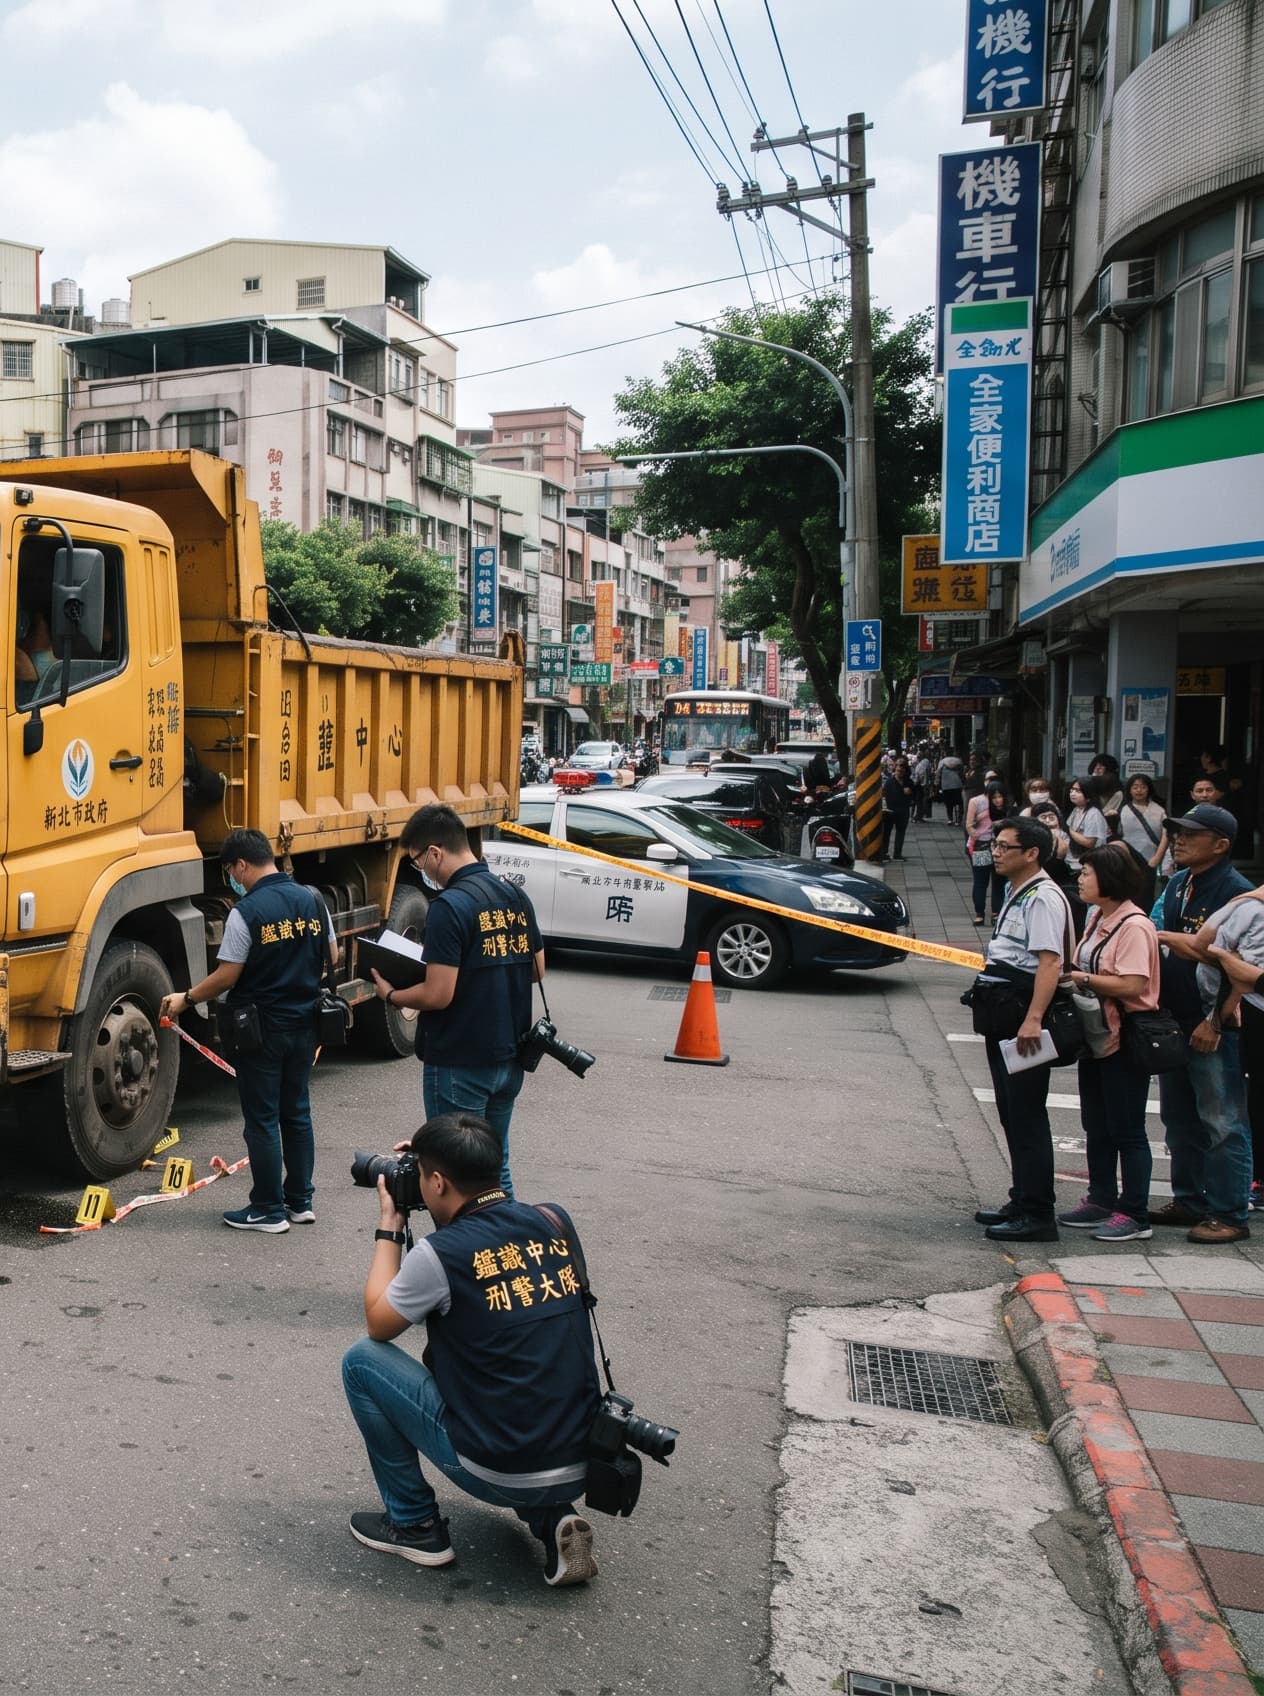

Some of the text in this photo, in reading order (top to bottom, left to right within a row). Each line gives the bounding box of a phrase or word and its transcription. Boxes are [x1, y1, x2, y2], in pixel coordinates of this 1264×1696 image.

[976, 0, 1032, 110] 機行
[964, 373, 1004, 553] 全家便利商店
[44, 799, 107, 832] 新北市政府
[84, 1194, 100, 1219] 11
[472, 1238, 570, 1280] 鑑識中心
[485, 1264, 581, 1311] 刑警大隊
